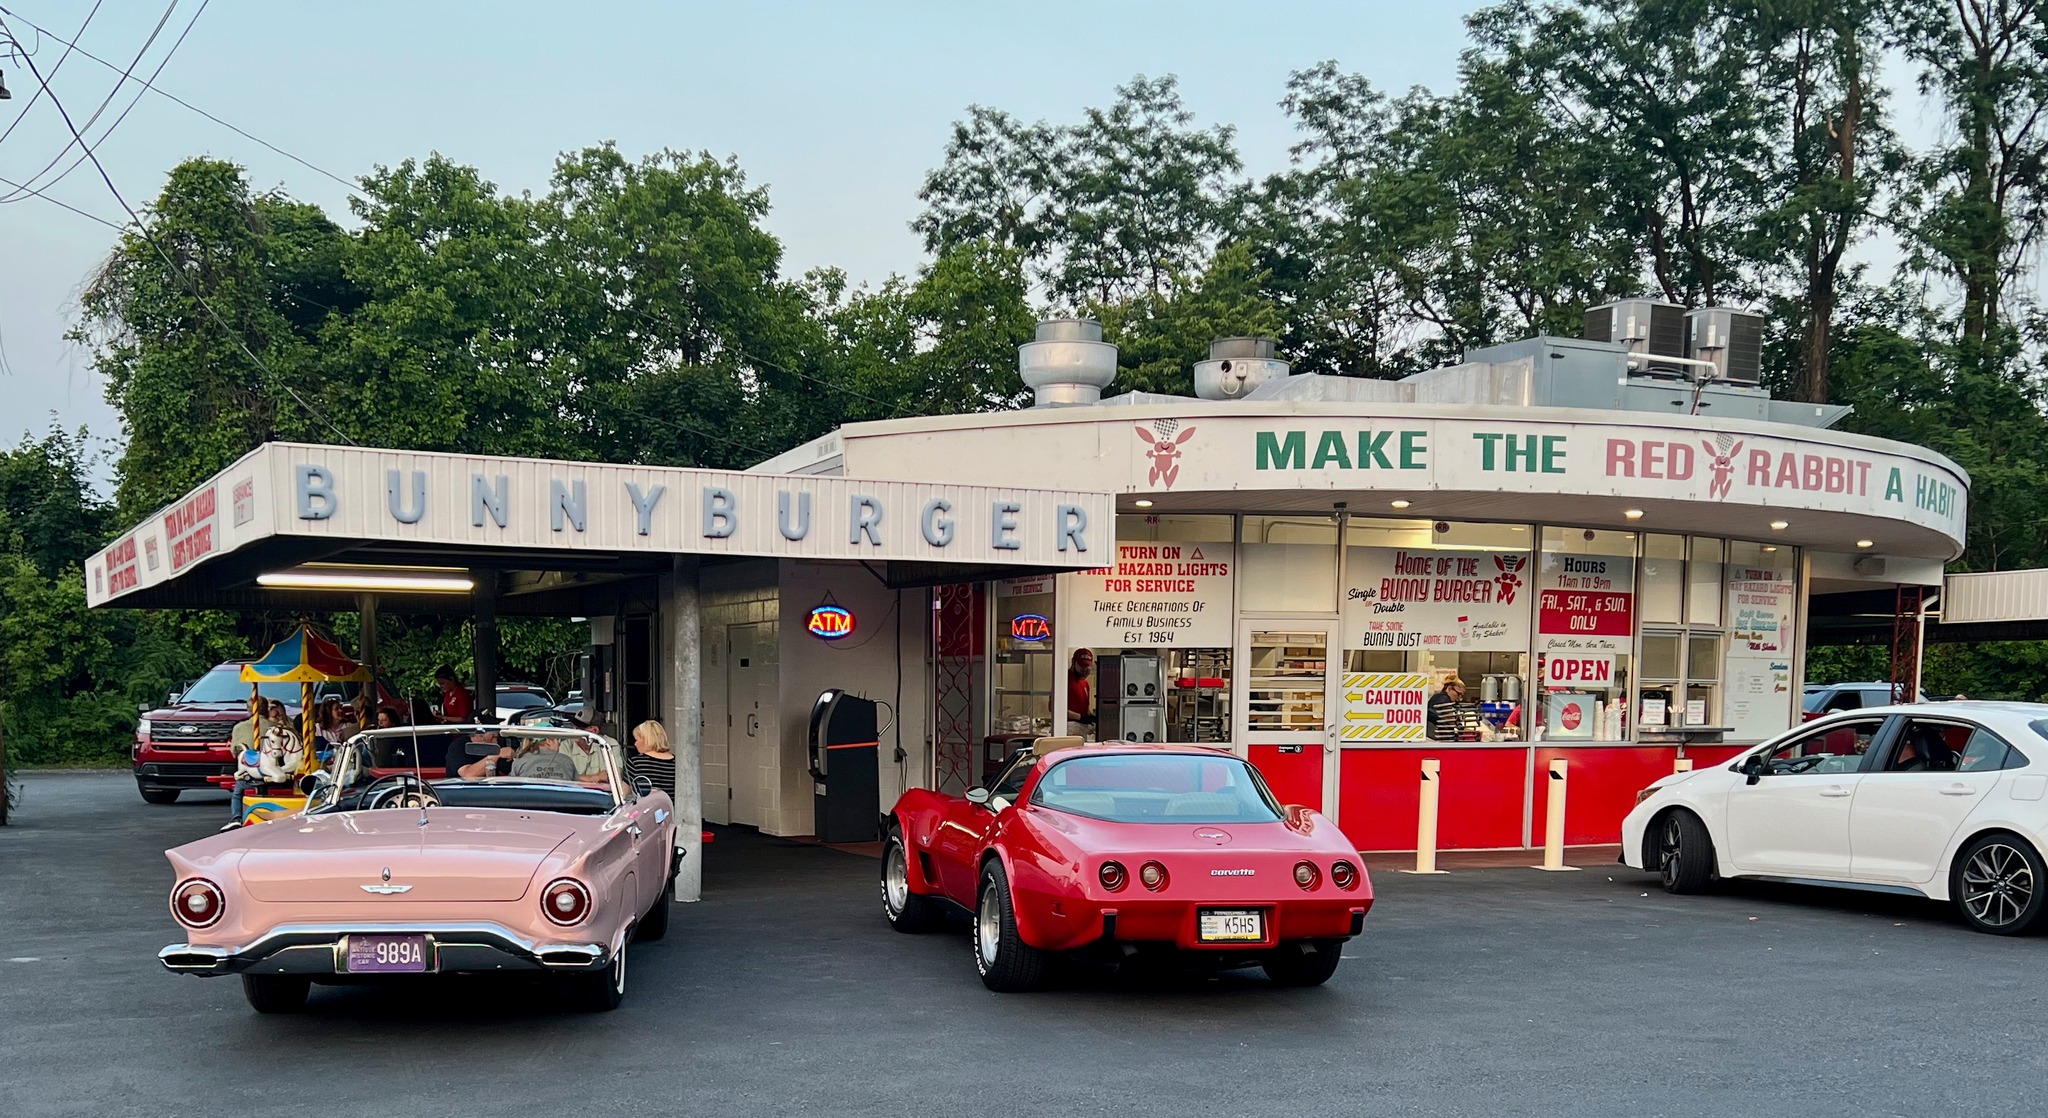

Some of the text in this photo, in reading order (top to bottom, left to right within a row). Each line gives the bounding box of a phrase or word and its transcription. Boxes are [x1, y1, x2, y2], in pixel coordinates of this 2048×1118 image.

[1255, 430, 1957, 521] MAKE THE RED RABBIT A HABIT
[1120, 546, 1181, 559] TURN ON
[1118, 563, 1173, 576] HAZARD
[1177, 563, 1228, 576] LIGHTS
[1394, 551, 1479, 577] HOME OF THE
[1564, 557, 1606, 574] HOURS
[1105, 579, 1195, 592] FOR SERVICE
[1558, 575, 1611, 590] 11AM TO 9PM
[1348, 578, 1492, 603] Single BUNNY BURGER
[1093, 600, 1122, 612] THREE
[1566, 595, 1592, 614] SAT.,
[1595, 599, 1602, 611] &
[1604, 597, 1627, 613] SUN.
[1737, 594, 1777, 606] FOR SERVICE
[1372, 602, 1405, 614] Double
[808, 613, 851, 632] ATM
[1369, 621, 1404, 632] TAKE SOME
[1472, 621, 1500, 630] Available
[1570, 615, 1597, 631] ONLY
[1149, 632, 1174, 643] 1964
[1363, 632, 1457, 647] BUNNY DUST HOME TOO!
[1547, 639, 1567, 649] Closed
[1551, 658, 1610, 681] OPEN
[1365, 690, 1423, 705] CAUTION
[1386, 709, 1422, 724] DOOR
[1225, 917, 1254, 934] K5HS
[376, 942, 421, 964] 989A
